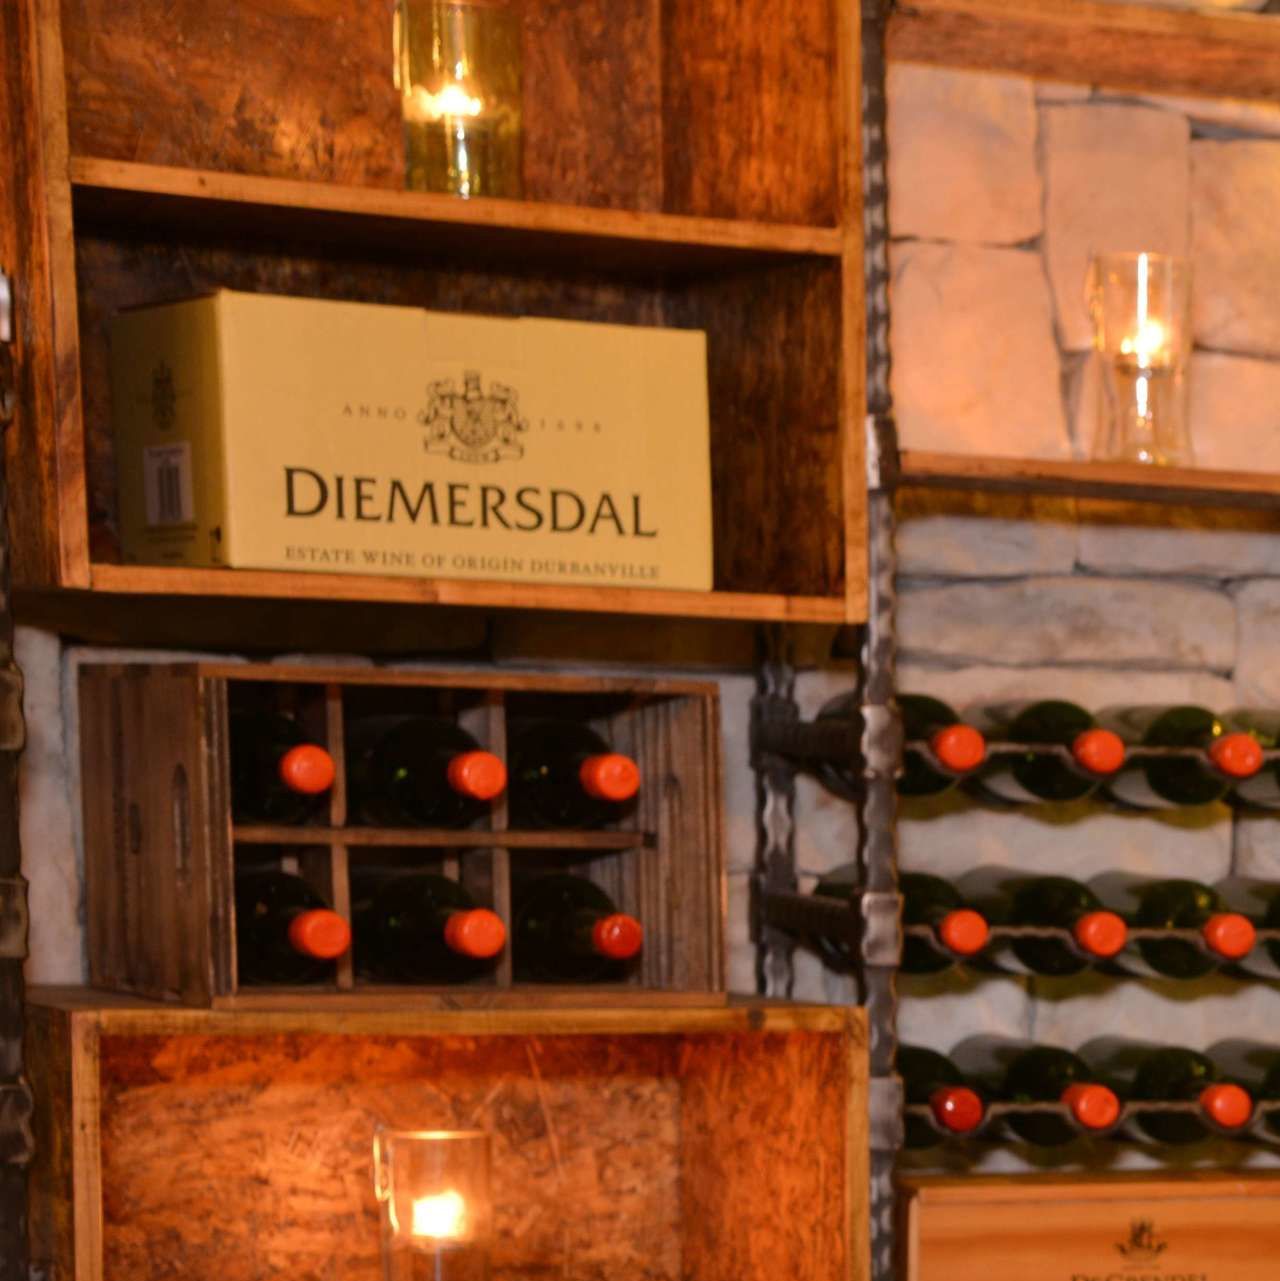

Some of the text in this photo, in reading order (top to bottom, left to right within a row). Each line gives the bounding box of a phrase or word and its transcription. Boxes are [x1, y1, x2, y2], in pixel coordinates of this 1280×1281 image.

[284, 466, 659, 537] DIEMERSDAL
[285, 545, 661, 579] ESTATE WINE OF ORIGIN DURBANVILLE
